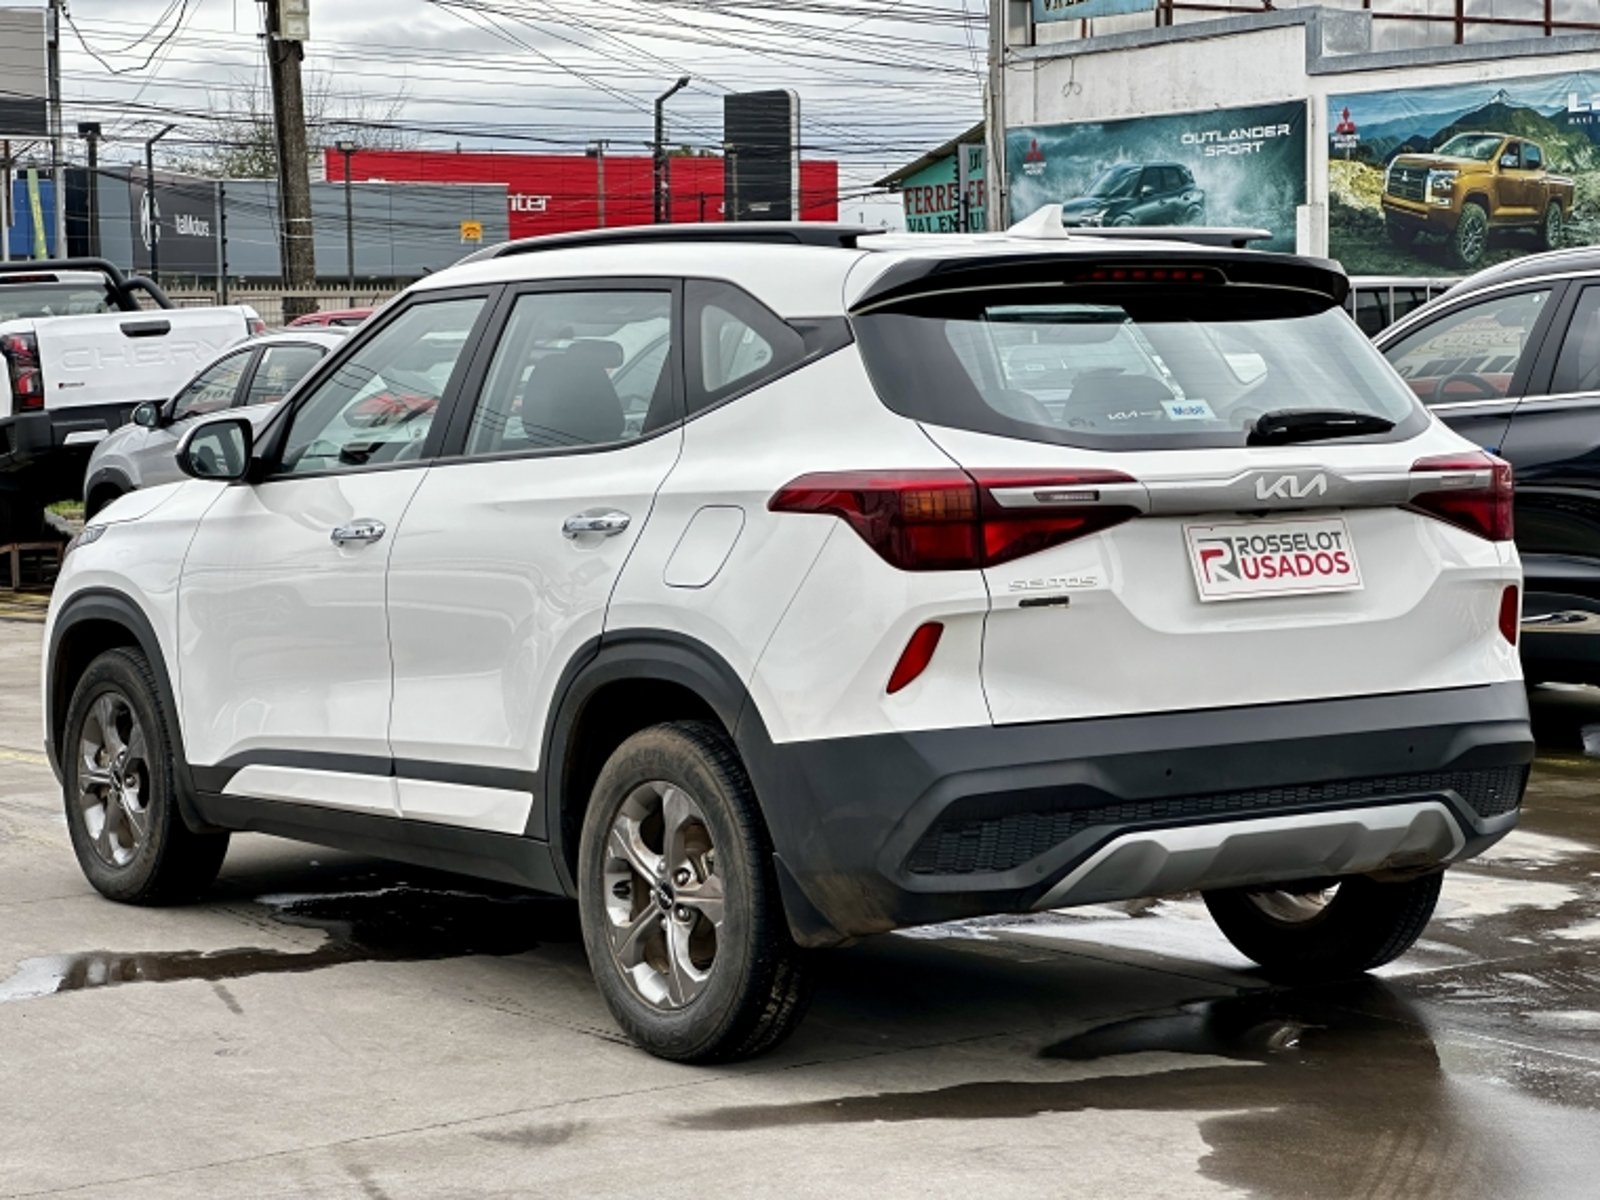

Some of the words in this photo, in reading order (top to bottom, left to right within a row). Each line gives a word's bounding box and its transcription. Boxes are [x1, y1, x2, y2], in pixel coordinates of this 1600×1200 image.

[1181, 123, 1291, 144] OUTLANDER
[1205, 141, 1264, 157] SPORT
[1255, 473, 1328, 500] KIA
[1235, 531, 1342, 555] ROSSELOT
[1240, 551, 1350, 580] USADOS
